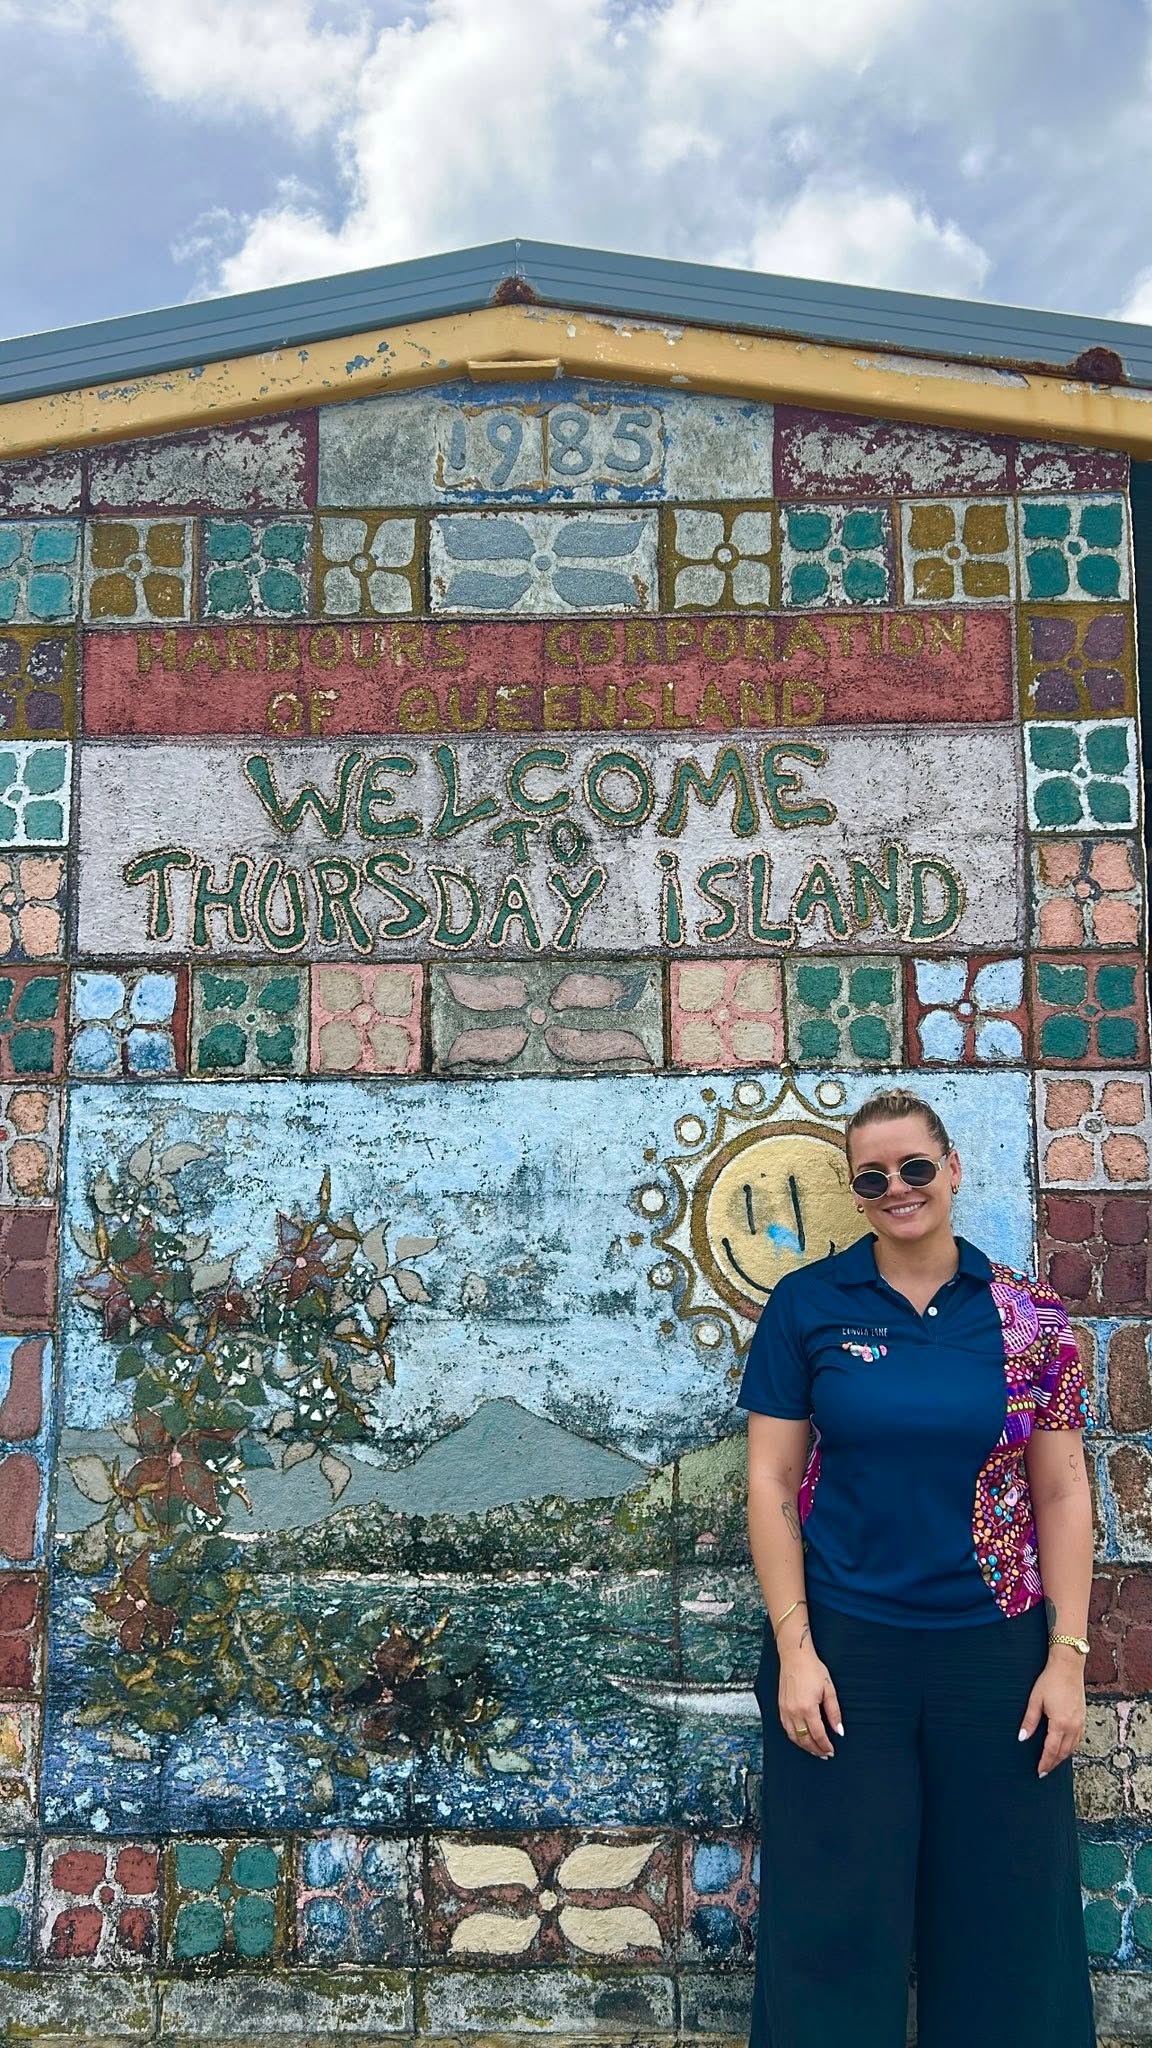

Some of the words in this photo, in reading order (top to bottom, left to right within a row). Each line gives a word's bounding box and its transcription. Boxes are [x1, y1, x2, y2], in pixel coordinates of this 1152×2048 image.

[448, 409, 652, 487] 1985
[136, 622, 468, 674] HARBOURS
[544, 614, 966, 667] CORPORATION
[266, 688, 340, 735] OF
[399, 678, 825, 732] QUEENSLAND
[243, 740, 838, 840] WELCOME
[490, 818, 586, 867] TO
[124, 847, 606, 956] THURSDAY
